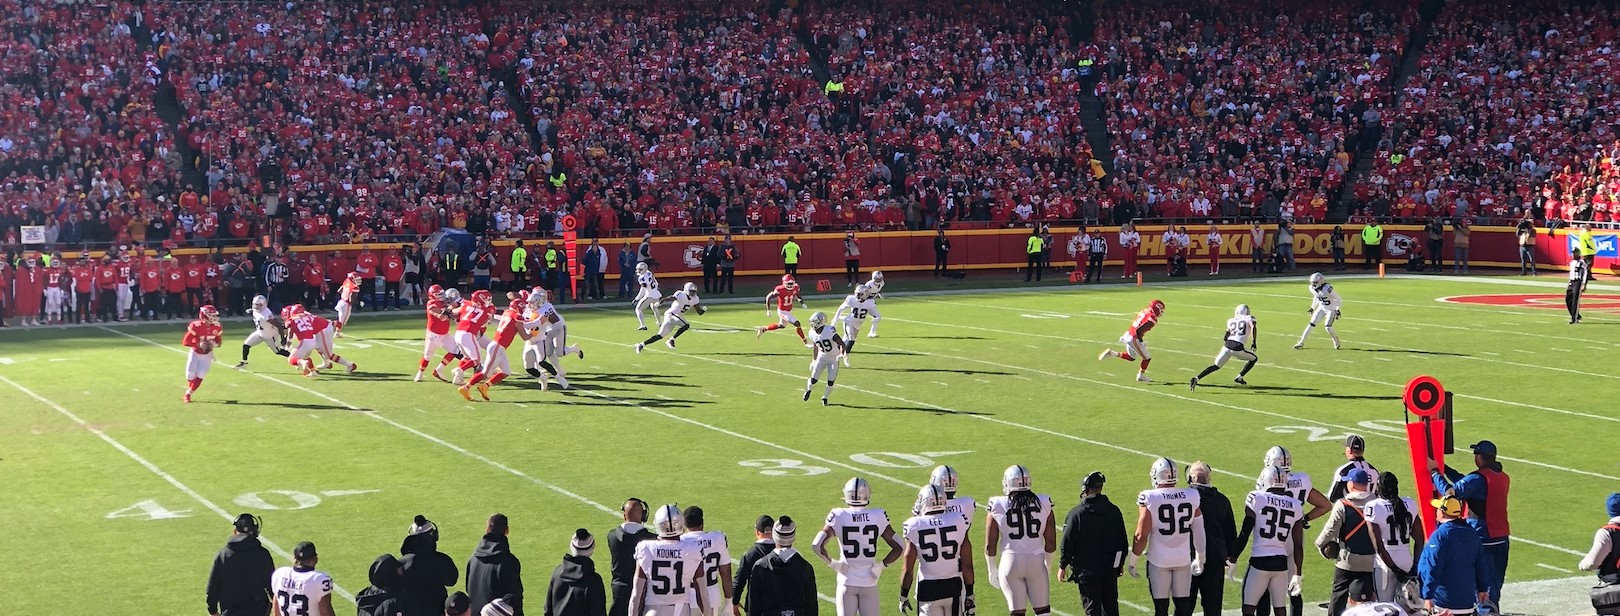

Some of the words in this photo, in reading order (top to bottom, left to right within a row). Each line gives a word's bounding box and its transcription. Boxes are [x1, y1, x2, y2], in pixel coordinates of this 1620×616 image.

[50, 274, 60, 284] 17
[784, 296, 794, 306] 11
[462, 306, 484, 324] 77
[852, 307, 868, 318] 42
[294, 316, 314, 332] 25
[1162, 492, 1186, 500] THOMAS
[1267, 496, 1294, 508] FACYSON
[852, 513, 870, 522] WHITE
[929, 518, 943, 526] LEE
[1006, 508, 1041, 540] 96
[1158, 502, 1192, 536] 92
[1260, 505, 1295, 542] 35
[842, 524, 879, 558] 53
[918, 526, 958, 562] 55
[656, 548, 682, 559] KOONCE
[652, 560, 685, 595] 51
